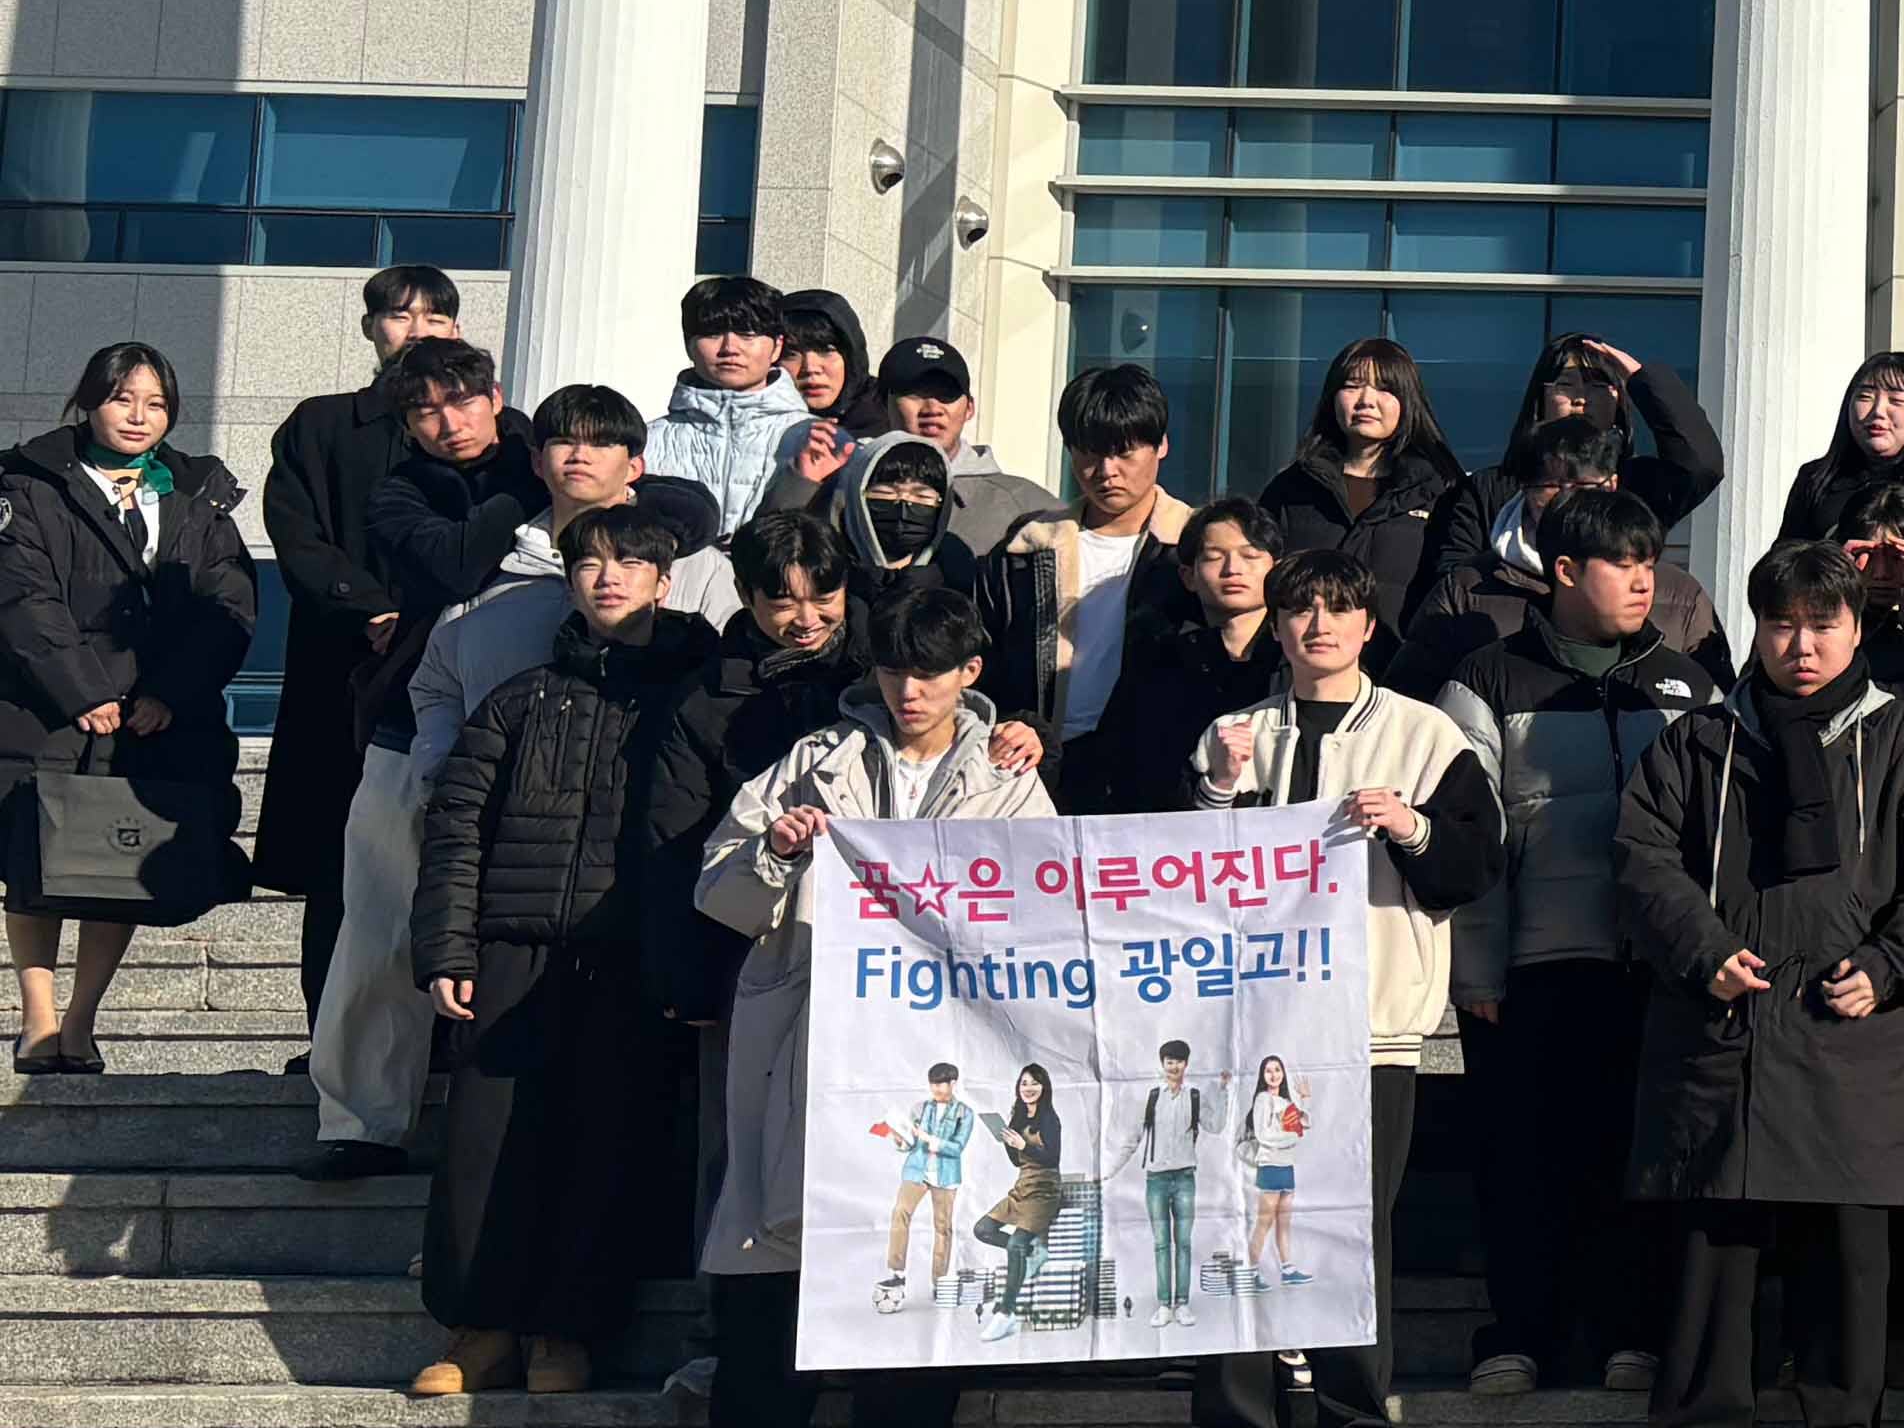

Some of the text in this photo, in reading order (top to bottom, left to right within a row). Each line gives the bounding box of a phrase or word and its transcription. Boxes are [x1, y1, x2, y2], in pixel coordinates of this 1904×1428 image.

[1034, 838, 1339, 912] 이루어진다.
[855, 927, 1332, 1010] Fighting 광일고!!
